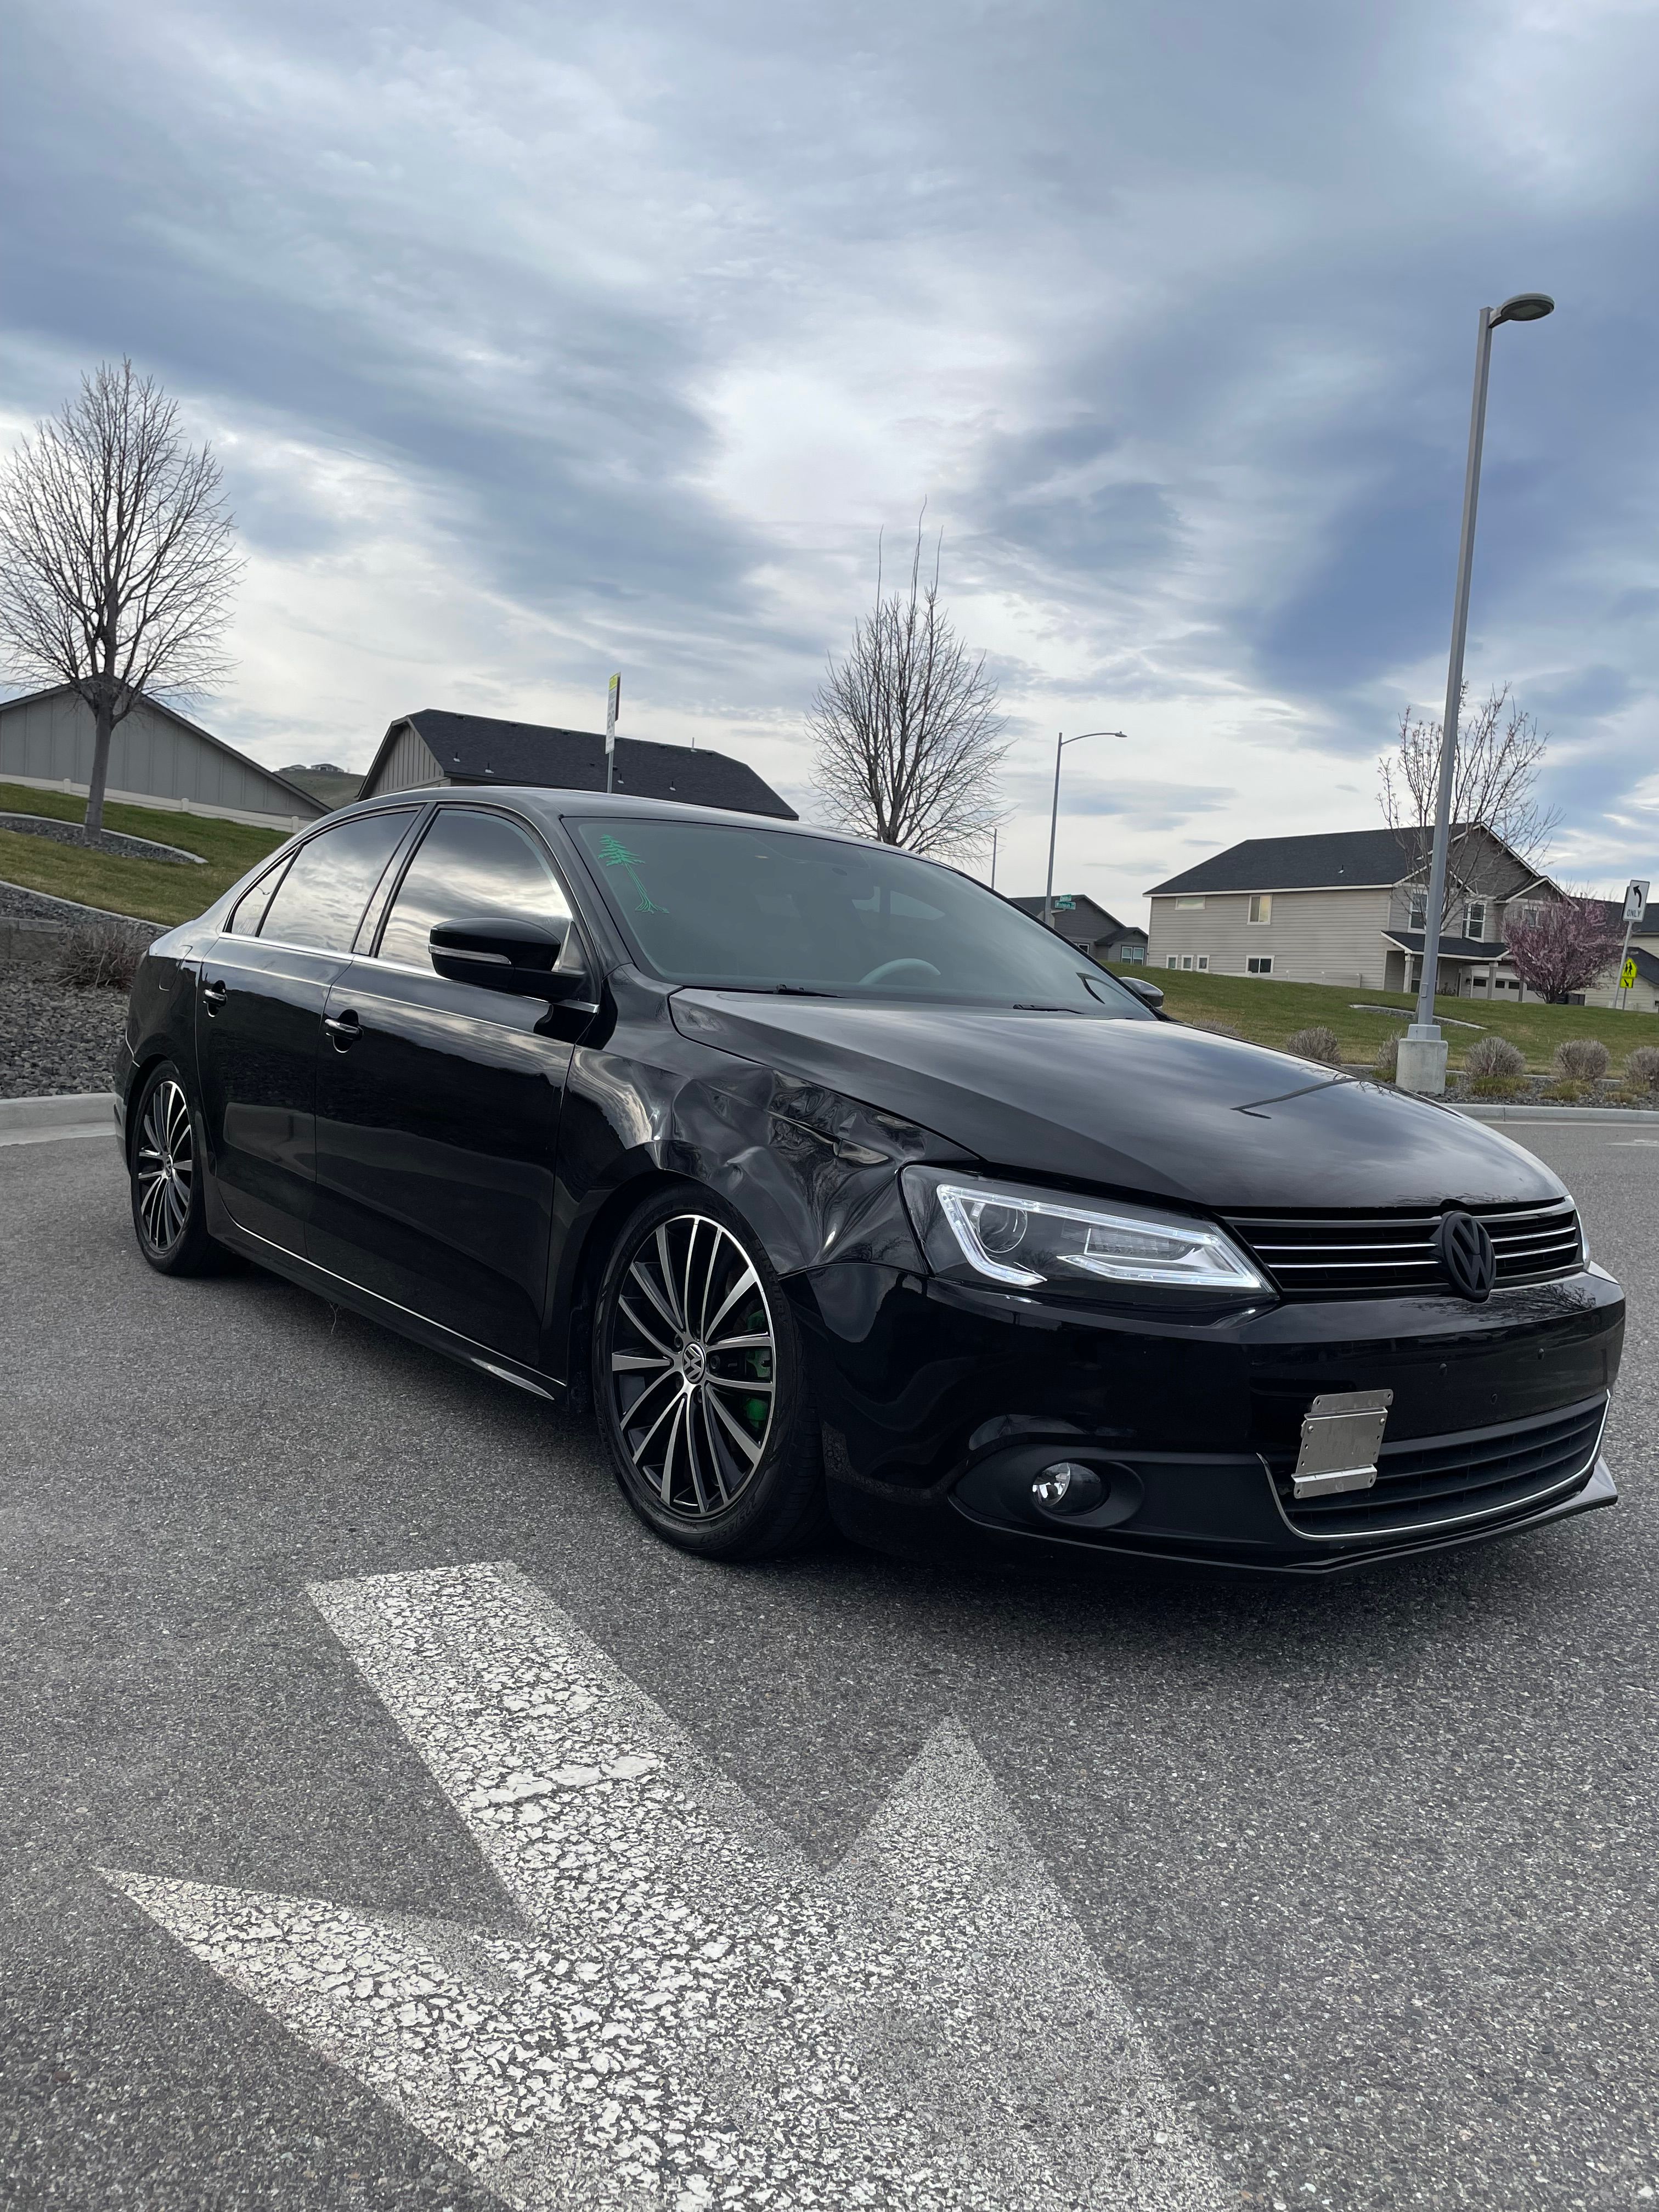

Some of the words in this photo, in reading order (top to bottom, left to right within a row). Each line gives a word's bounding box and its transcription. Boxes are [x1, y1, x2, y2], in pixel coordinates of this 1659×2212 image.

[607, 710, 614, 729] 20
[1627, 909, 1641, 917] ONLY
[1449, 1214, 1495, 1295] VW
[683, 1342, 704, 1383] VW
